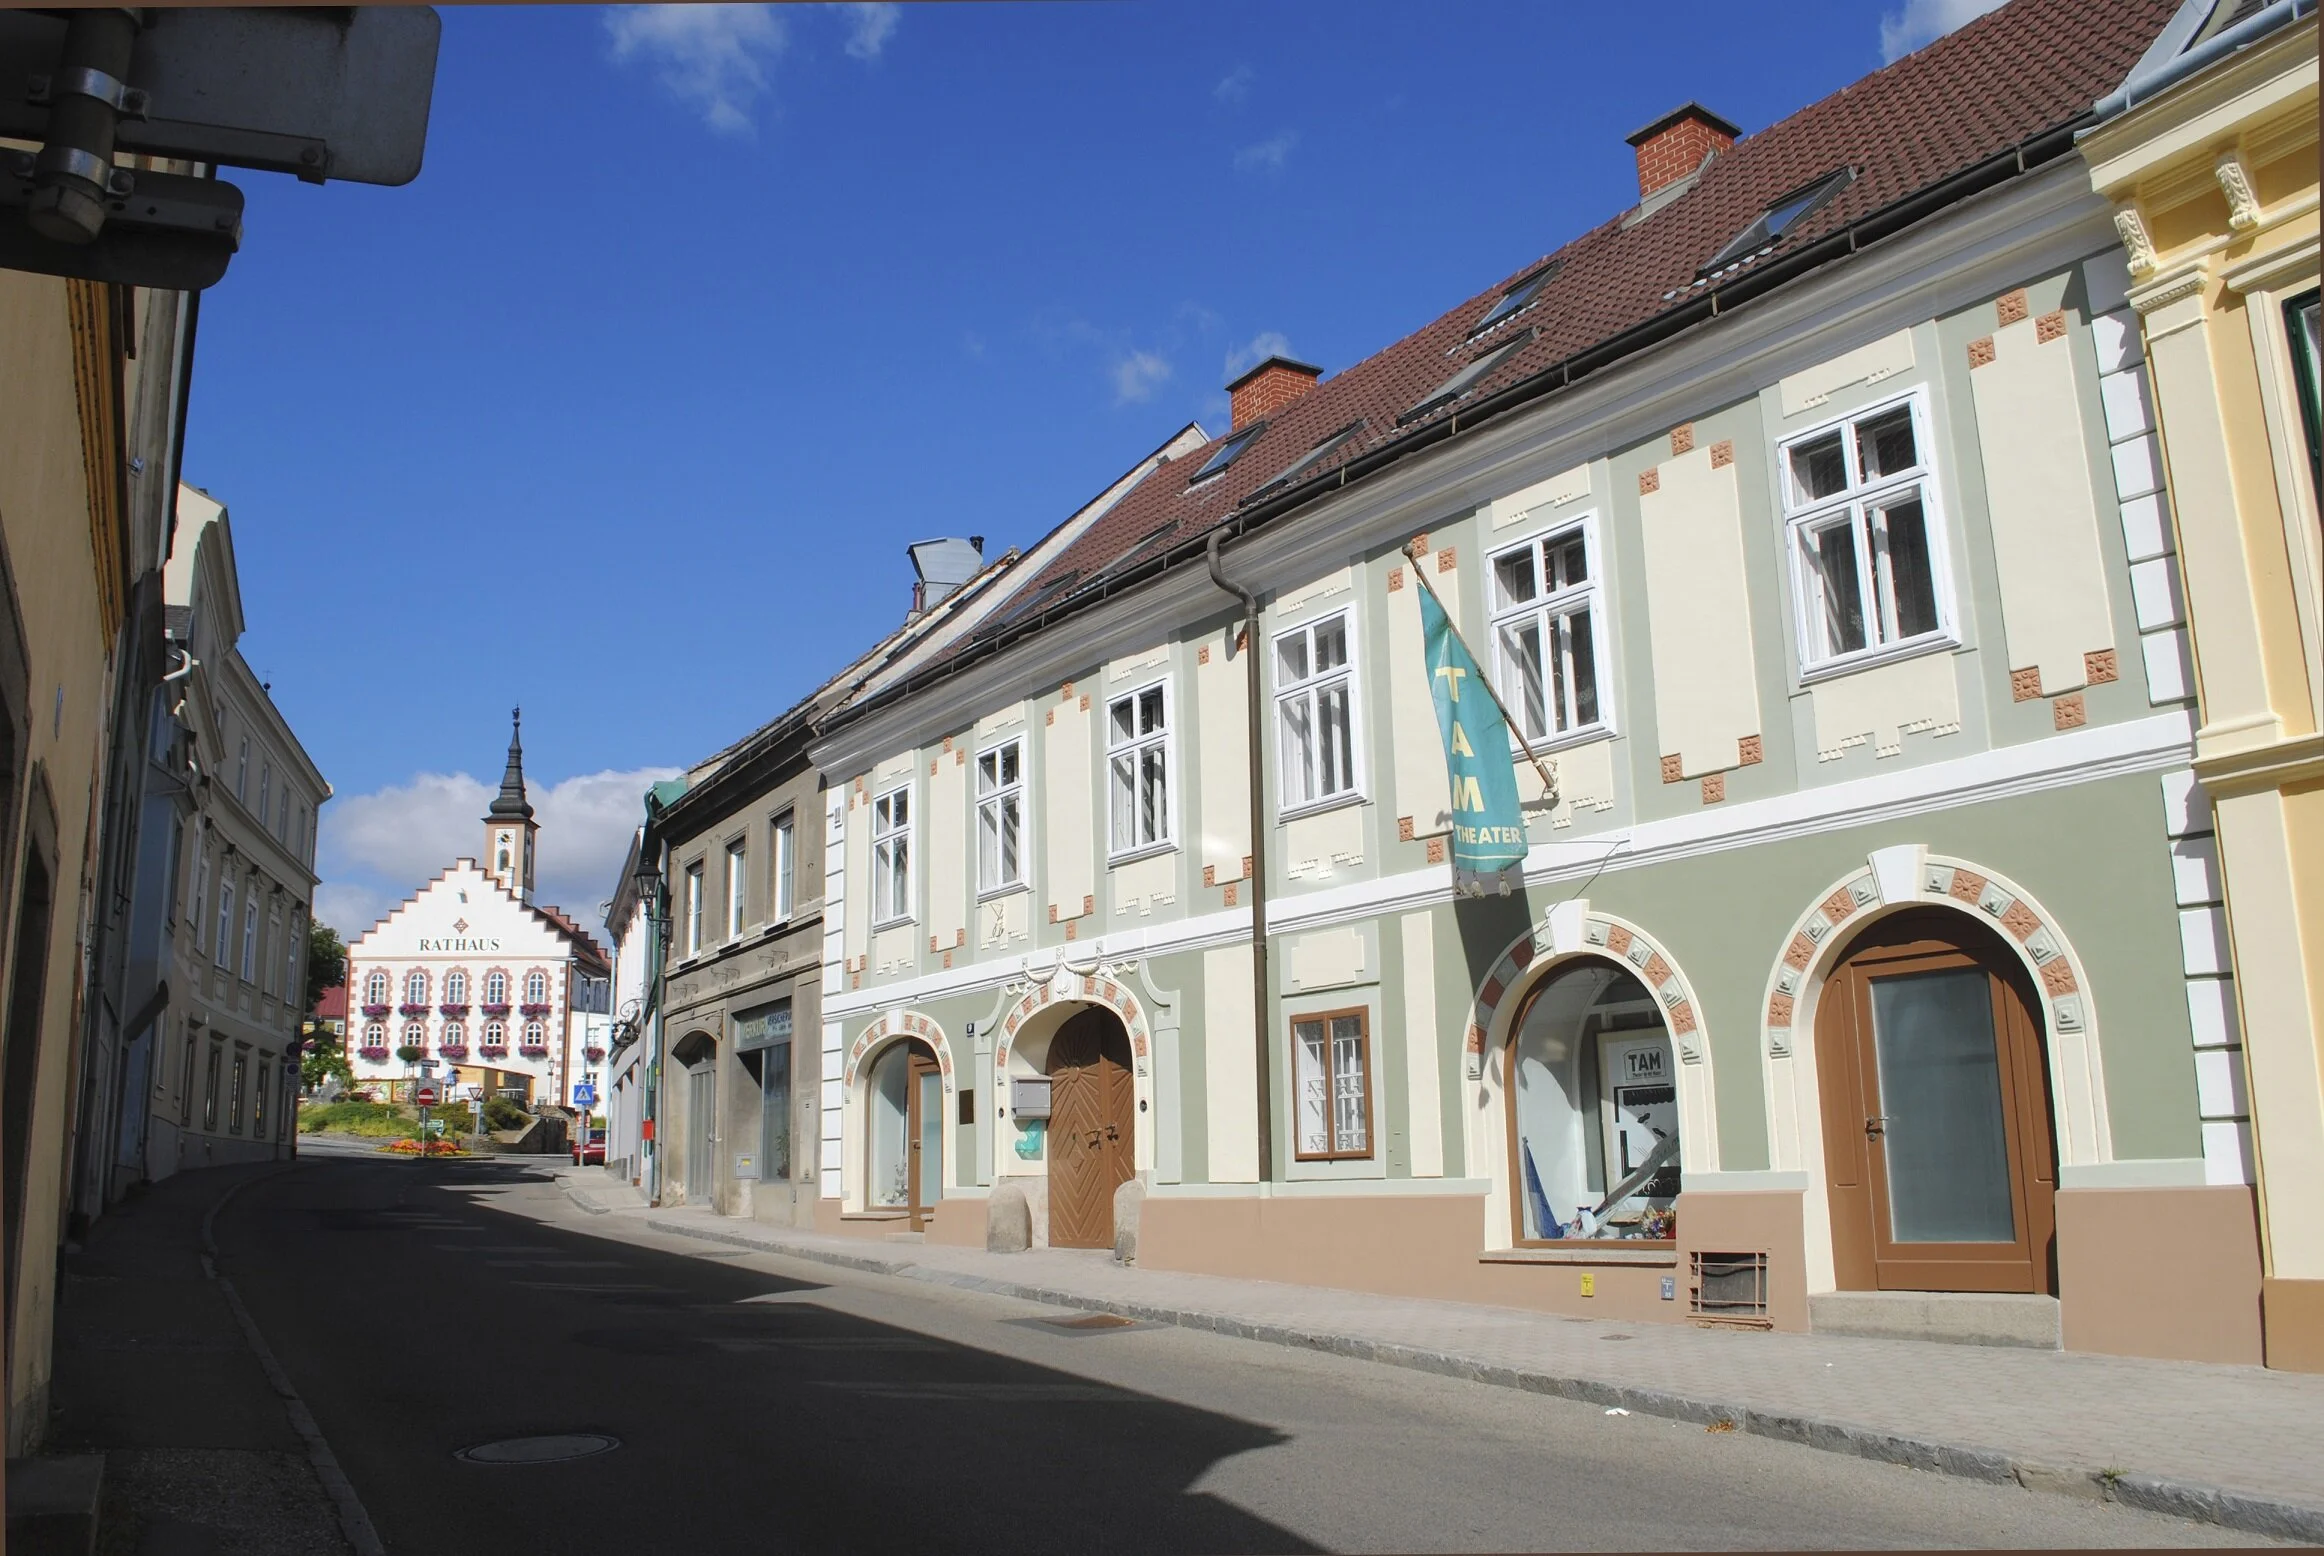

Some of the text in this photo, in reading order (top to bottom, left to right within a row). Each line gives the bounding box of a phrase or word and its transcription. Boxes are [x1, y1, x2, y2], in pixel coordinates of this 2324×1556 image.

[1434, 666, 1485, 813] TAM
[1454, 824, 1522, 844] THEATER
[419, 938, 500, 951] RATHAUS
[1628, 1052, 1661, 1072] TAM
